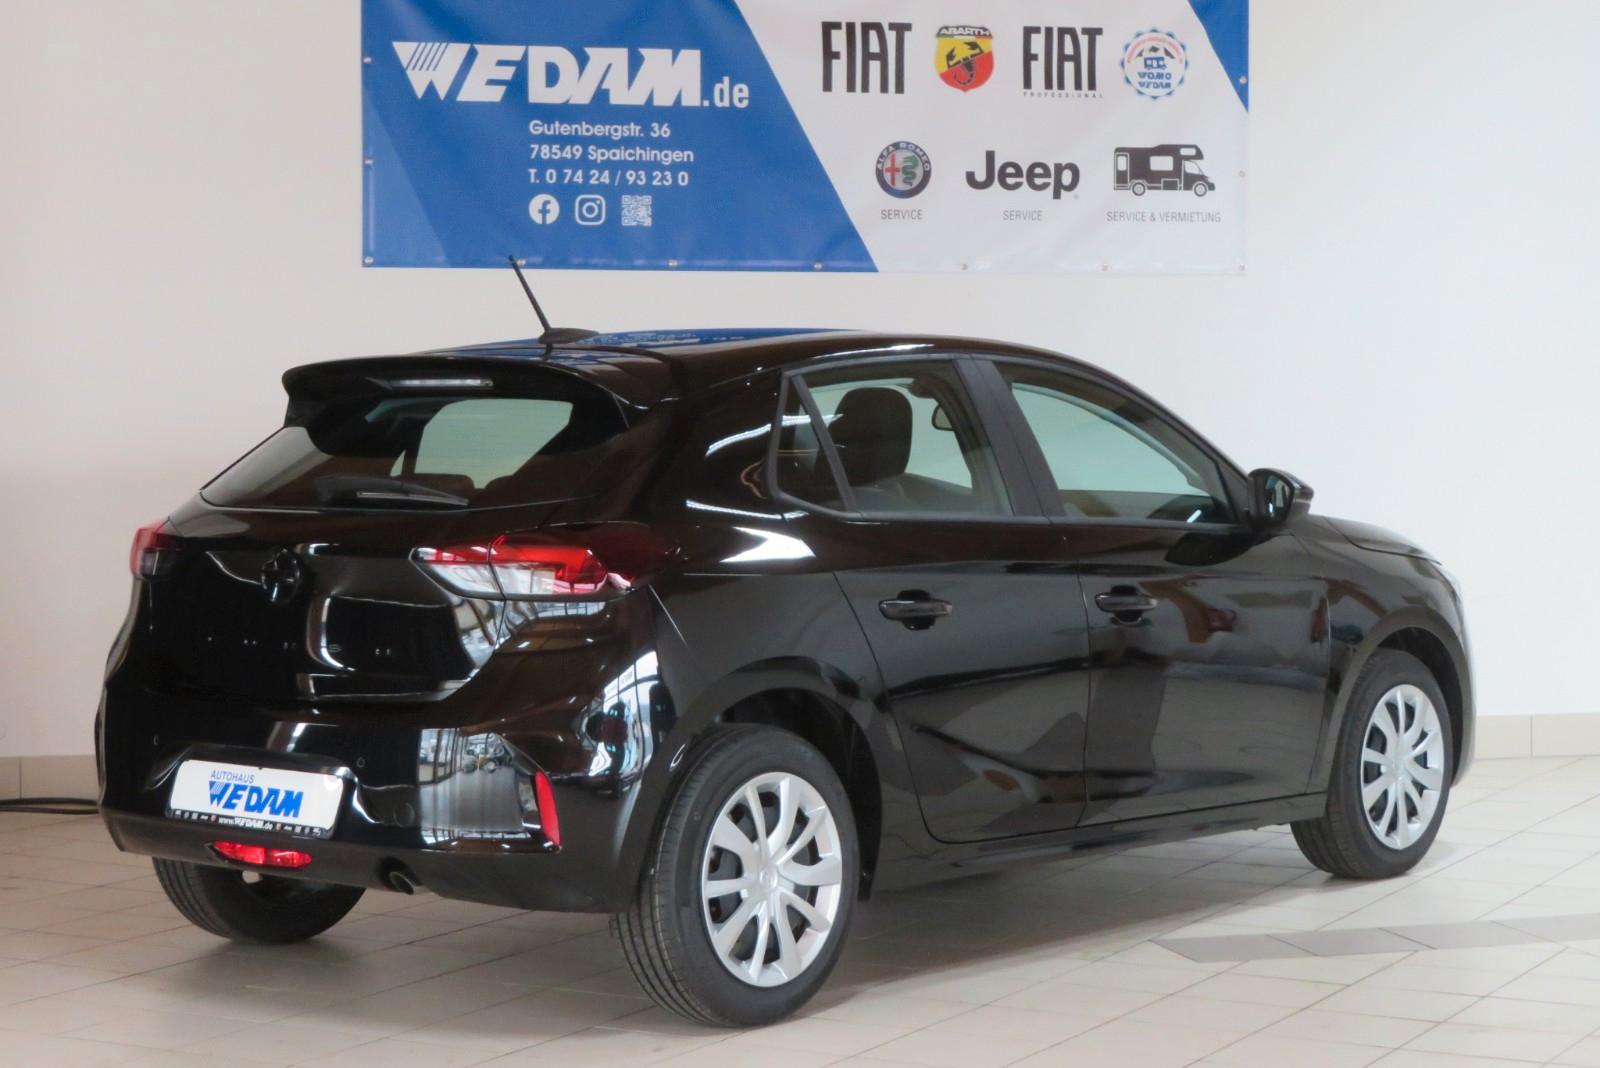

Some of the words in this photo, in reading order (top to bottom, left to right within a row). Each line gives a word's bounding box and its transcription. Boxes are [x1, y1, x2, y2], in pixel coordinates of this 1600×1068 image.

[939, 27, 991, 36] ABARTH
[821, 21, 912, 94] FIAT
[1022, 26, 1103, 91] FIAT
[529, 120, 644, 140] Gutenbergstr.
[650, 123, 671, 138] 36
[530, 144, 583, 160] 78549
[588, 145, 695, 165] Spaichingen
[877, 145, 897, 170] ALFA
[899, 142, 931, 171] ROMEO
[528, 169, 540, 184] T.
[545, 169, 557, 184] 0
[563, 169, 583, 184] 74
[589, 170, 610, 185] 24
[614, 170, 622, 186] /
[626, 171, 647, 185] 93
[652, 171, 673, 186] 23
[678, 171, 689, 186] 0
[965, 150, 1080, 200] Jeep
[881, 209, 923, 220] SERVICE
[1003, 210, 1043, 221] SERVICE
[1106, 211, 1146, 222] SERVICE
[1150, 212, 1156, 222] &
[1159, 212, 1222, 223] VERMIETUNG
[211, 770, 255, 783] AUTOHAUS
[208, 780, 304, 818] WEDAM
